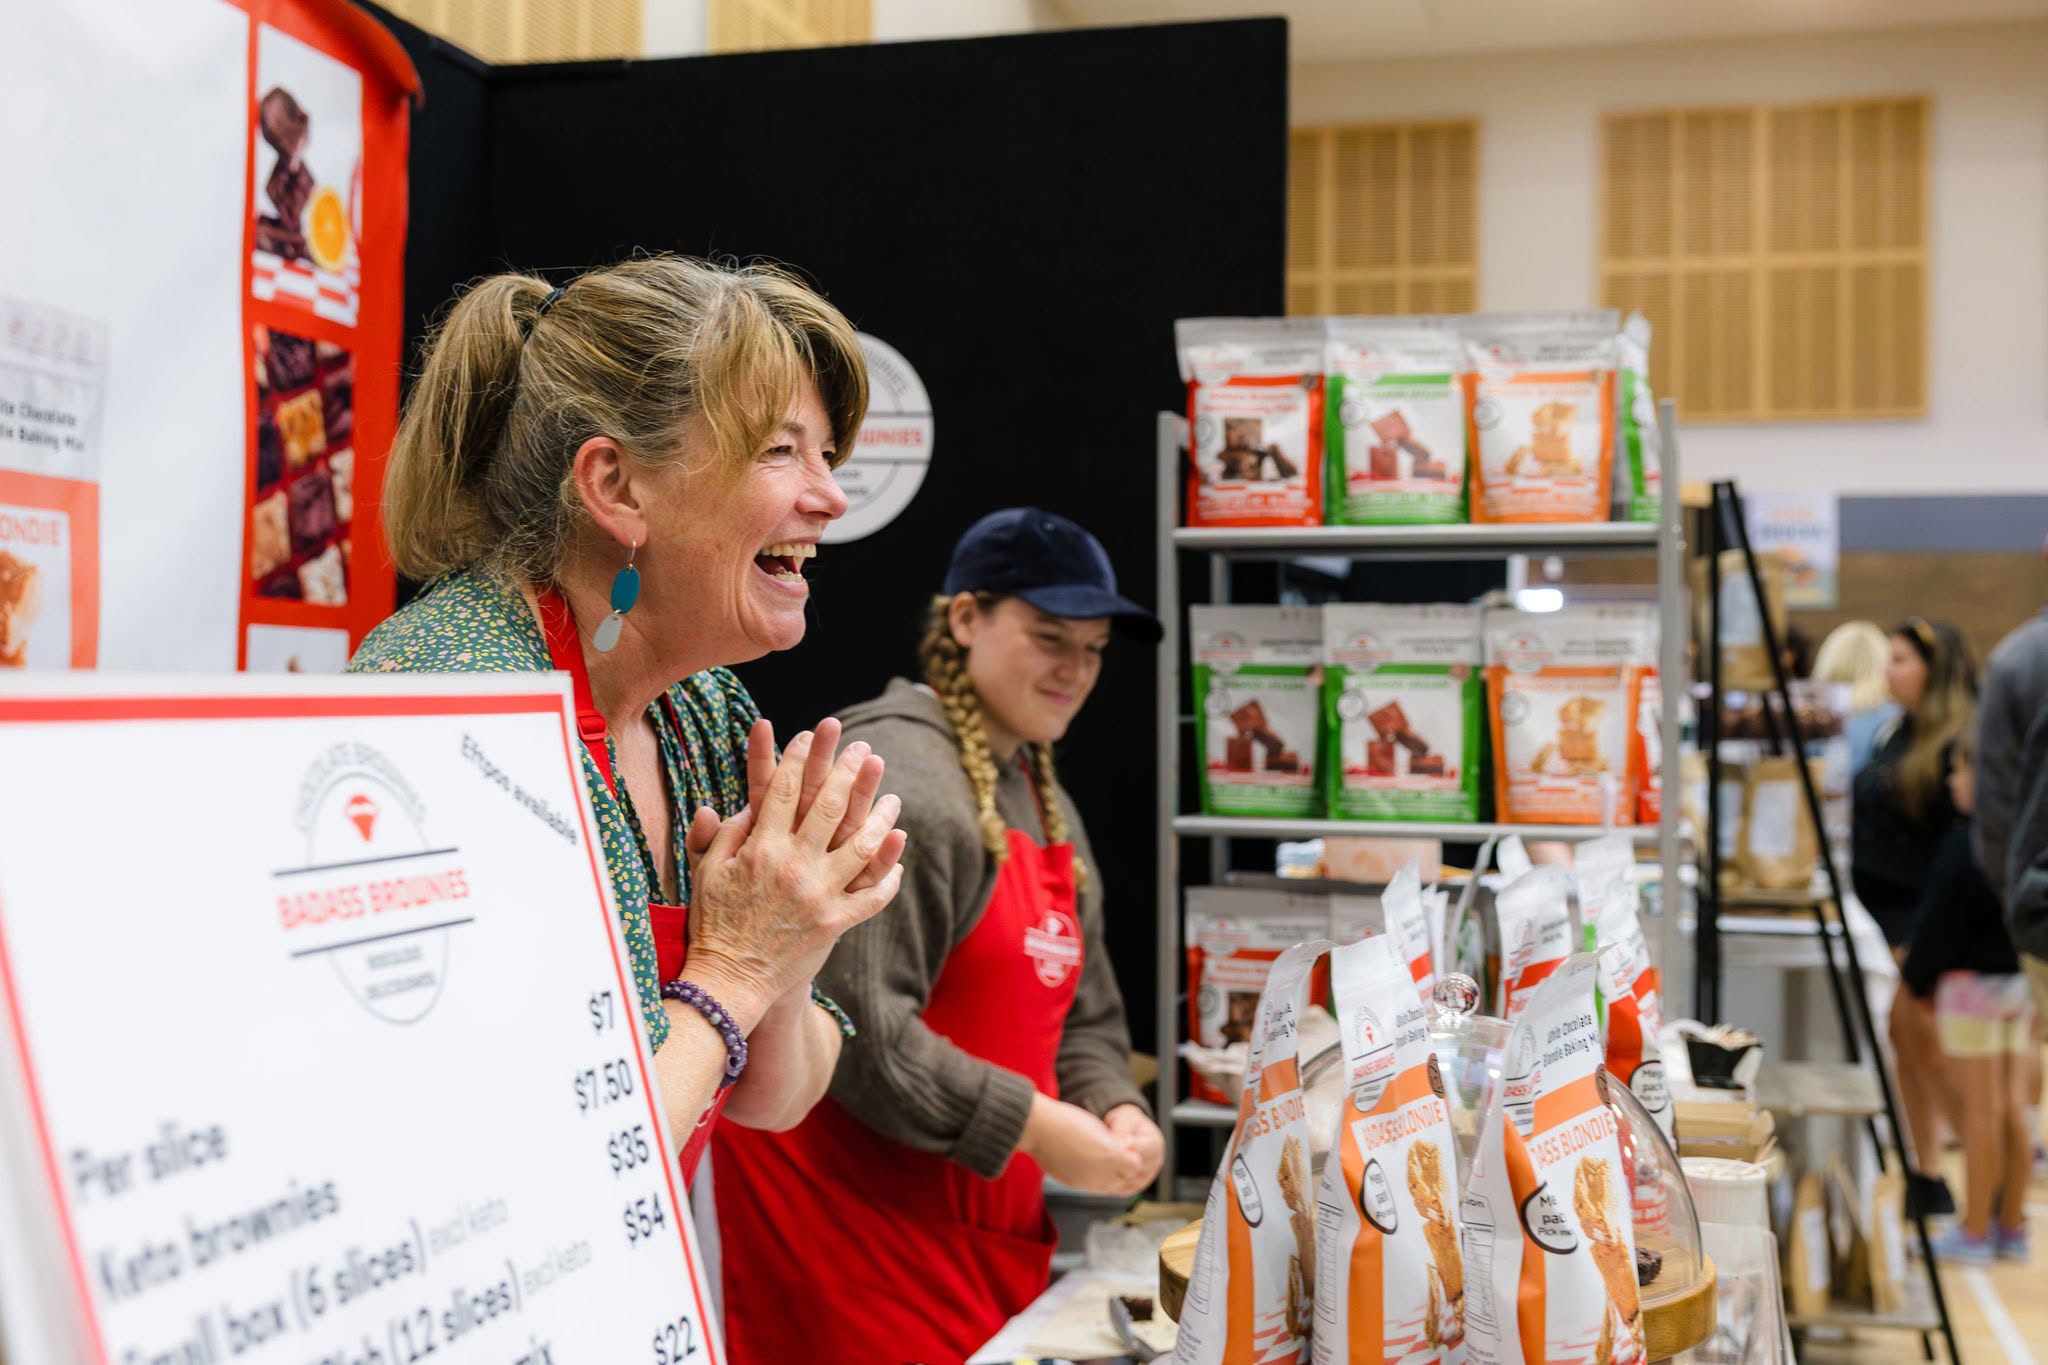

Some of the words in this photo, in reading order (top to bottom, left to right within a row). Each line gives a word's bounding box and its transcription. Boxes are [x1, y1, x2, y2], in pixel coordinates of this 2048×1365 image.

[19, 401, 77, 426] Chocolate
[19, 425, 59, 451] Baking
[64, 436, 84, 451] Mix
[0, 513, 61, 546] ONDIE
[514, 784, 577, 845] available
[277, 885, 365, 930] BADASS
[367, 869, 470, 914] BROWNIES
[589, 990, 615, 1032] $7
[574, 1057, 634, 1112] $7.50
[608, 1124, 650, 1175] $35
[1560, 1112, 1614, 1156] BLONDIE
[70, 1148, 133, 1203] Per
[146, 1120, 228, 1180] slice
[98, 1243, 182, 1303] Keto
[185, 1178, 340, 1267] brownies
[623, 1192, 667, 1246] $54
[1542, 1212, 1567, 1226] pac
[220, 1303, 286, 1355] box
[290, 1264, 327, 1331] (6
[334, 1217, 426, 1304] slices)
[389, 1308, 437, 1365] (12
[442, 1258, 522, 1342] slices)
[653, 1314, 697, 1365] $22
